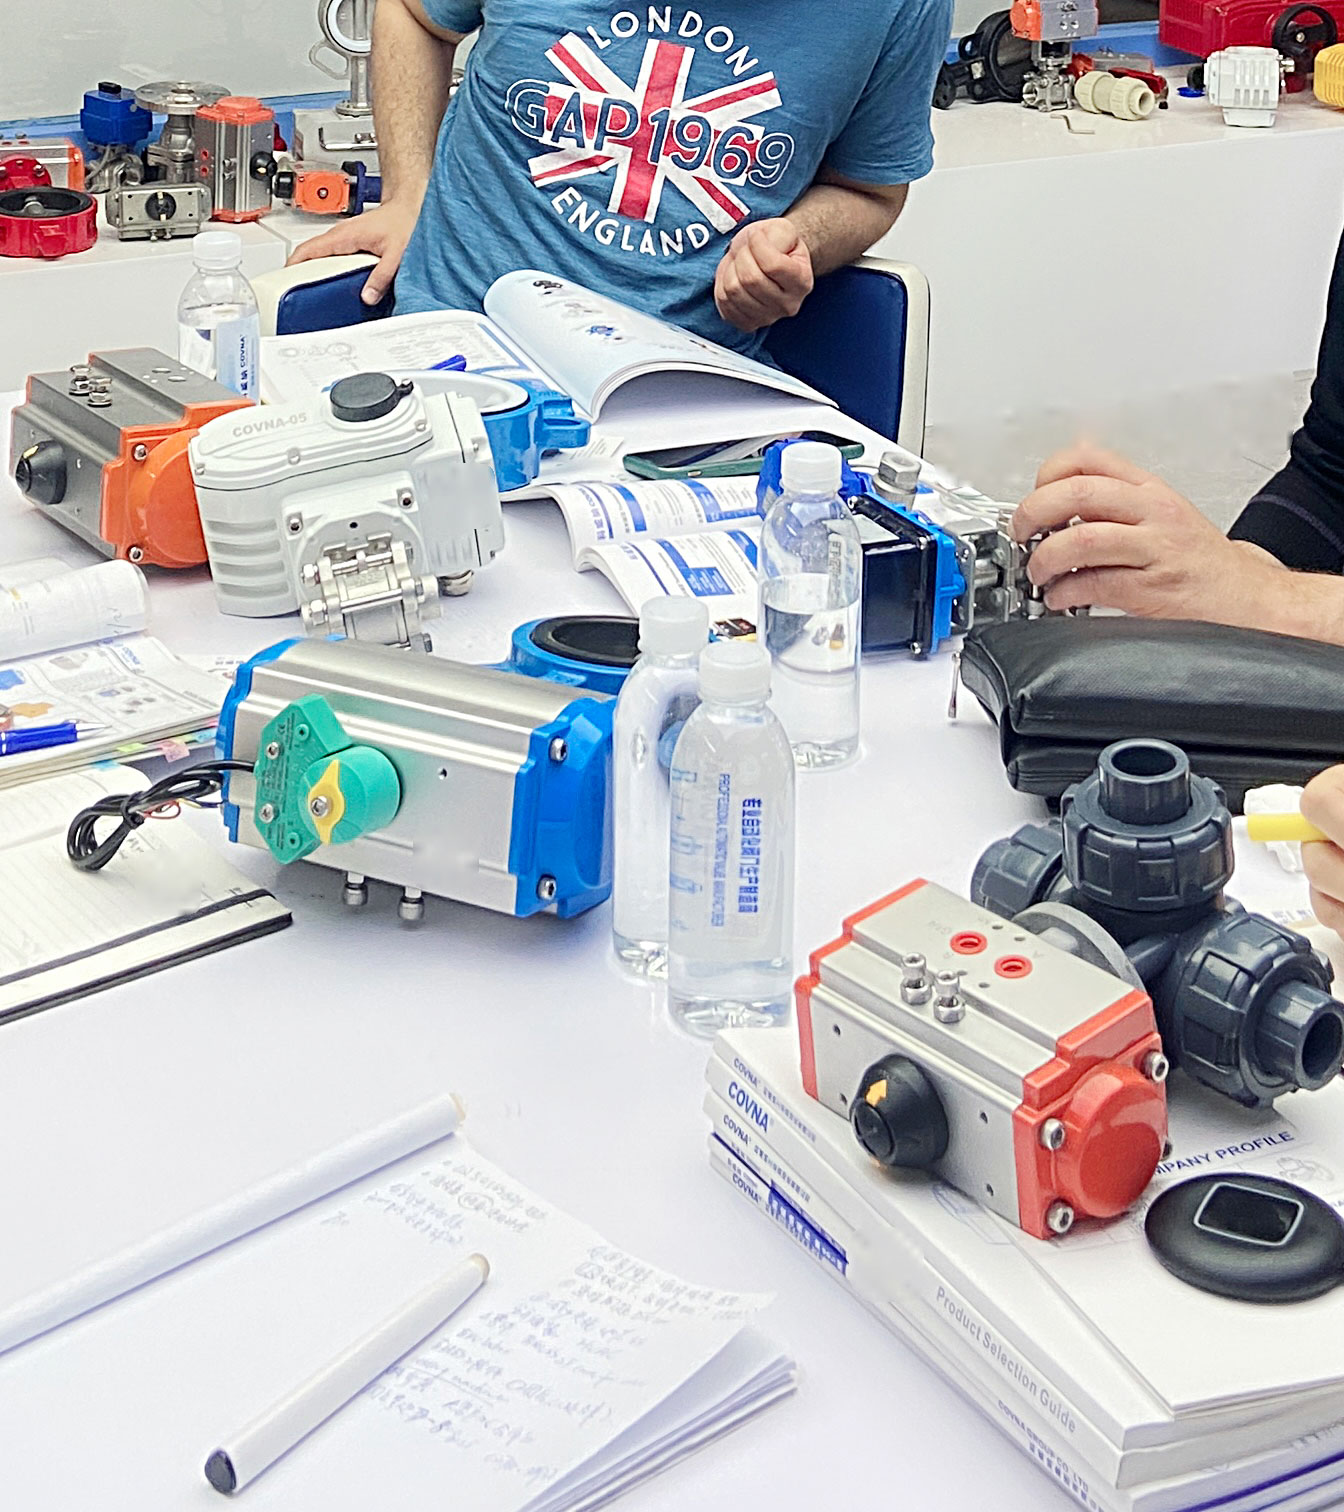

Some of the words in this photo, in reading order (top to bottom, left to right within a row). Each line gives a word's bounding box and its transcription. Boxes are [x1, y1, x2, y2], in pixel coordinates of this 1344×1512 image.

[586, 5, 759, 78] LONDON
[551, 186, 710, 257] ENGLAND
[232, 412, 307, 437] COVNA-05
[733, 1057, 757, 1088] COVNA
[723, 1114, 750, 1146] COVNA
[728, 1081, 770, 1133] COVNA
[1154, 1153, 1213, 1176] MPANY
[1215, 1130, 1296, 1161] PROFILE
[732, 1172, 759, 1204] COVNA
[936, 1286, 982, 1341] Product
[982, 1332, 1038, 1397] Selection
[1039, 1388, 1076, 1434] Guide
